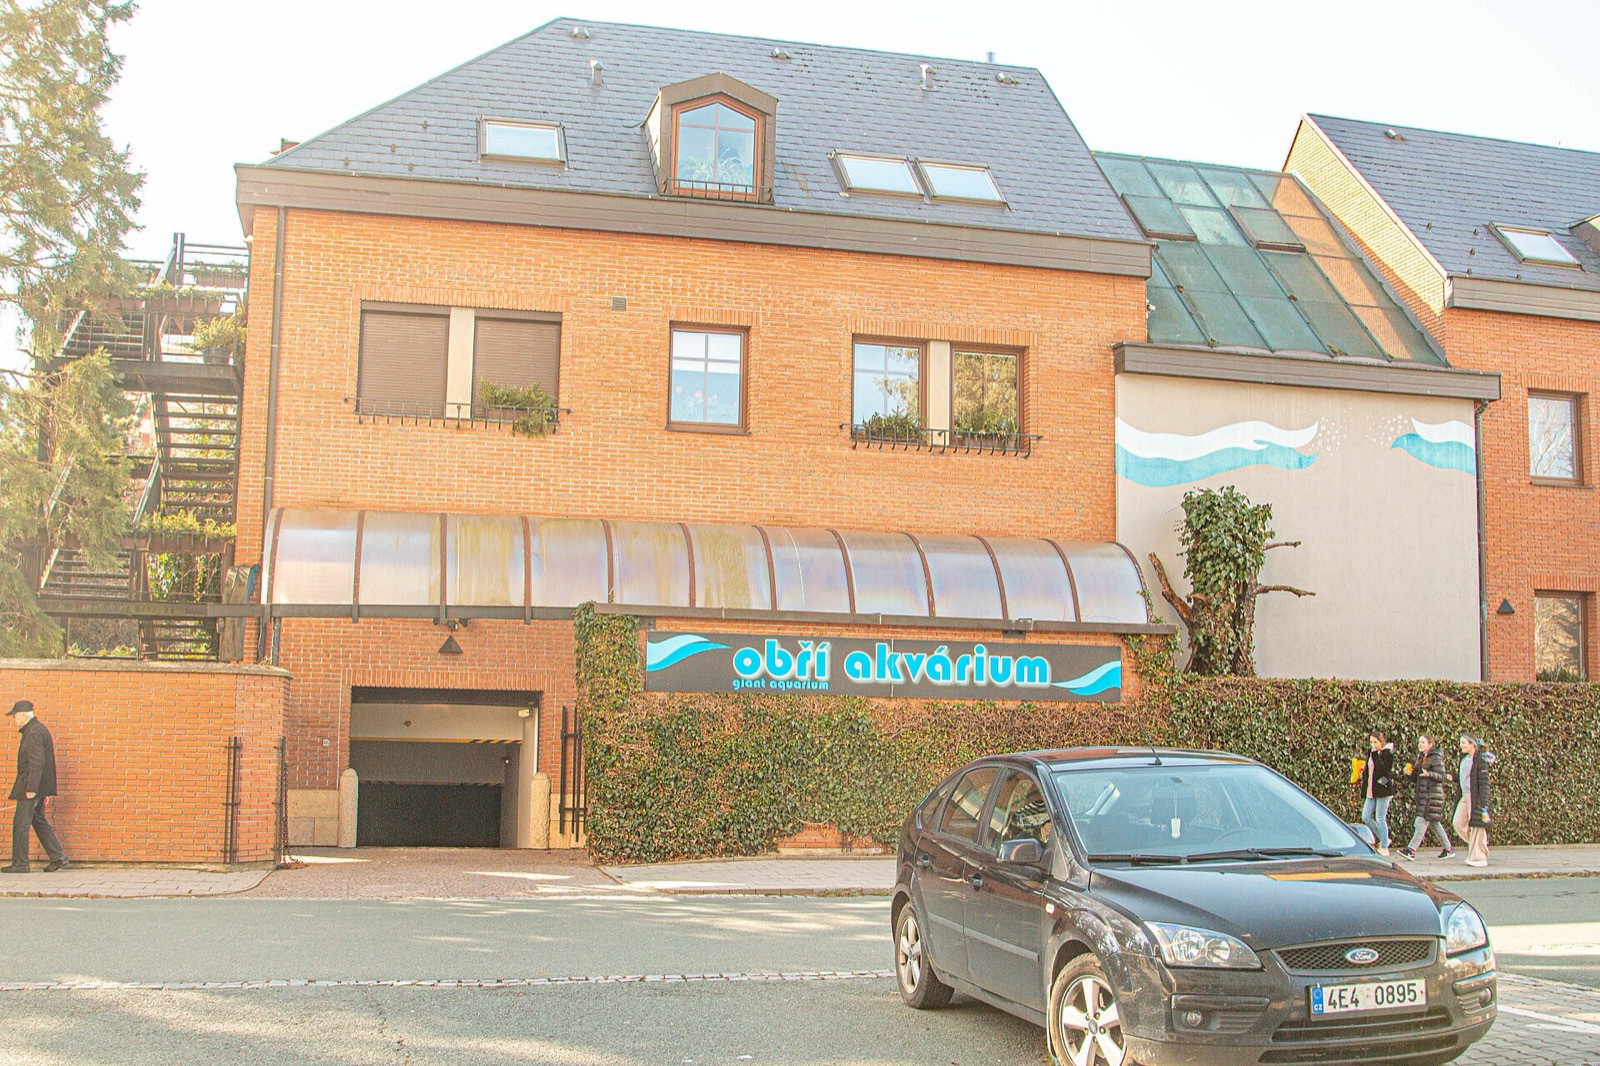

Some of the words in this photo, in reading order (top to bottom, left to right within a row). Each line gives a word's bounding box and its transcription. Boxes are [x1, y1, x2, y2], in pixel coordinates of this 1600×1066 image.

[732, 638, 830, 678] obří
[844, 643, 1051, 684] akvárium
[733, 678, 766, 691] giant
[769, 679, 829, 691] aquarium
[1328, 987, 1360, 1009] 4E4
[1375, 983, 1417, 1005] 0895
